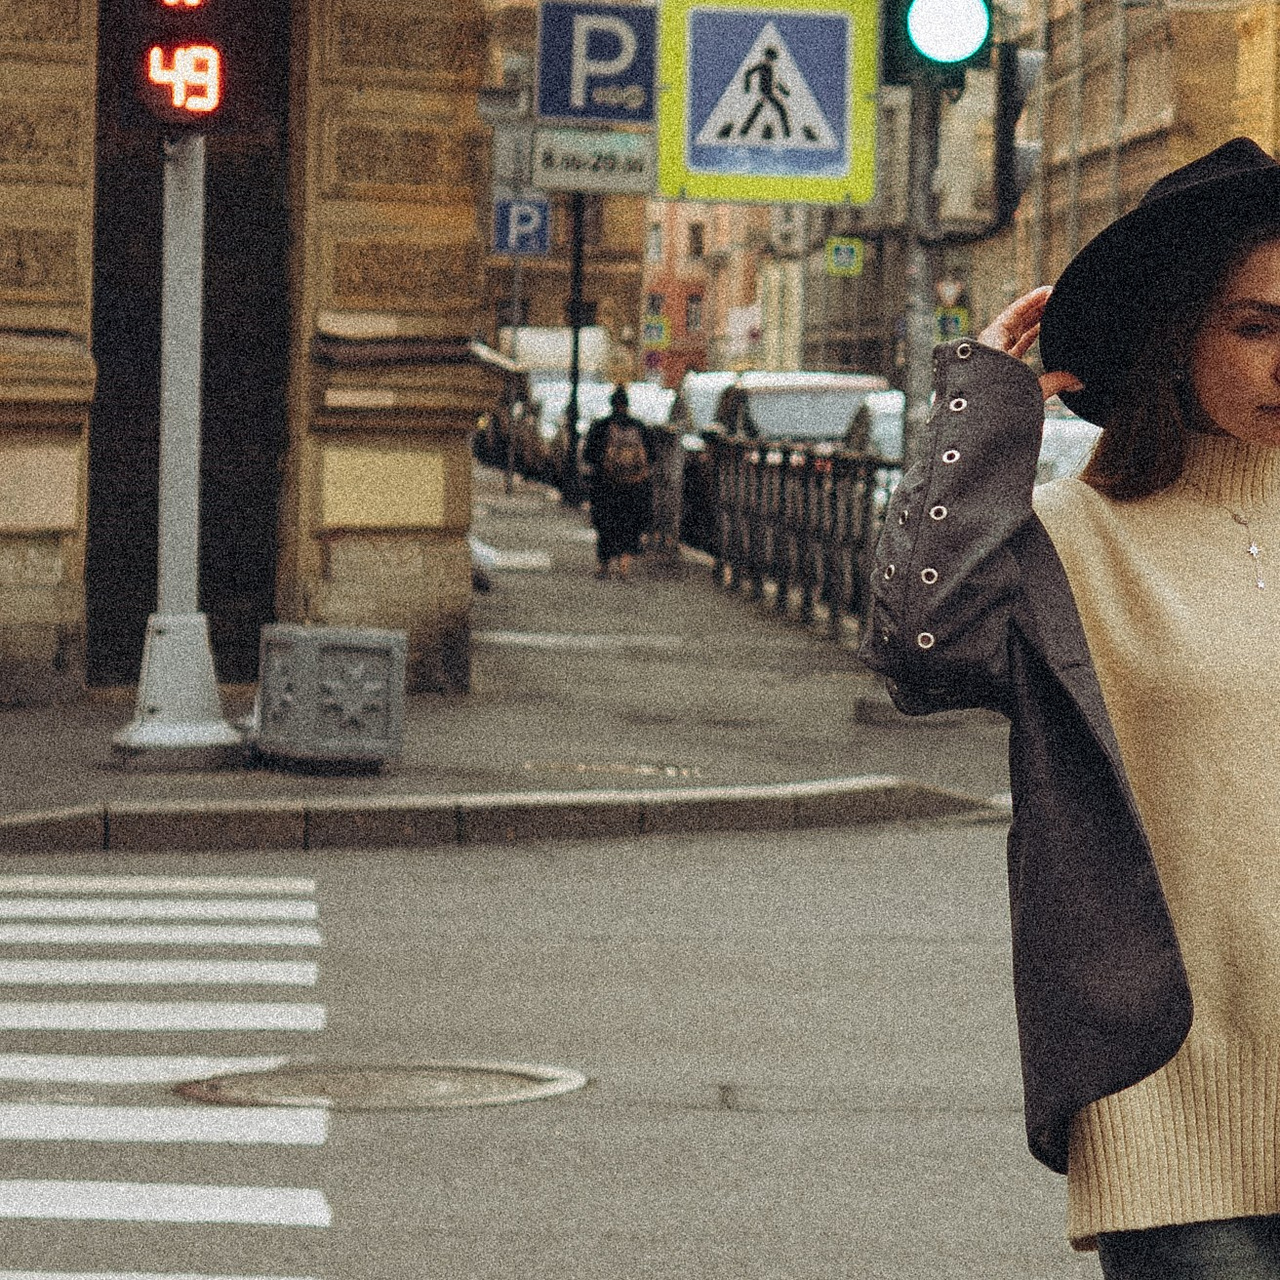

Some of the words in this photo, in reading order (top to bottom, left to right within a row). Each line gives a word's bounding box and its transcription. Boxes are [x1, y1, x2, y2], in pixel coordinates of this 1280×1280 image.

[148, 45, 220, 112] 49
[570, 13, 638, 110] P
[508, 203, 541, 249] P
